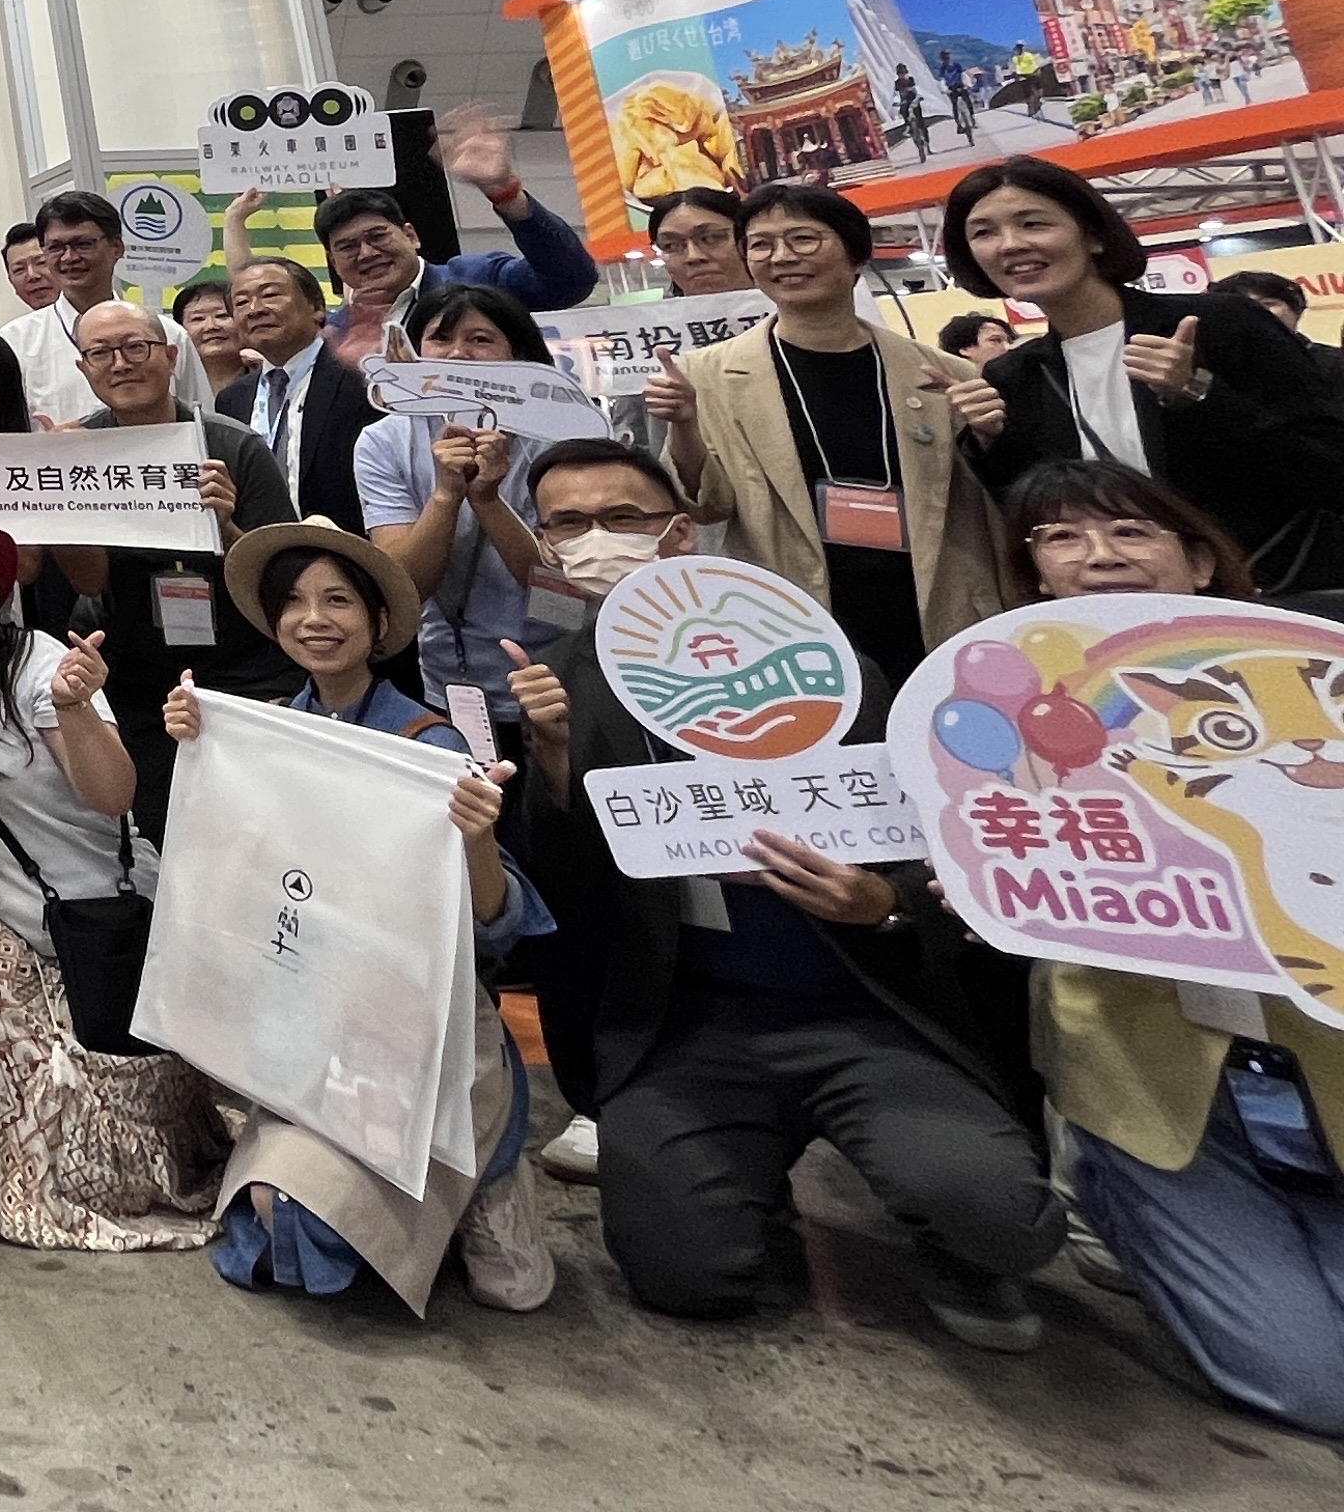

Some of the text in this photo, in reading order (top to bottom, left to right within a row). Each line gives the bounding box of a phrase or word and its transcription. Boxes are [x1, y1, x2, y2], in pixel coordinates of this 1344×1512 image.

[230, 160, 360, 174] RAILWAY MUSEUM
[260, 171, 332, 185] MIAOLI
[22, 500, 65, 512] Nature
[67, 499, 155, 512] Conservation
[157, 499, 207, 514] Agency
[604, 768, 908, 828] 白沙聖域 天空
[969, 790, 1146, 863] 幸福
[993, 866, 1232, 932] Miaoli
